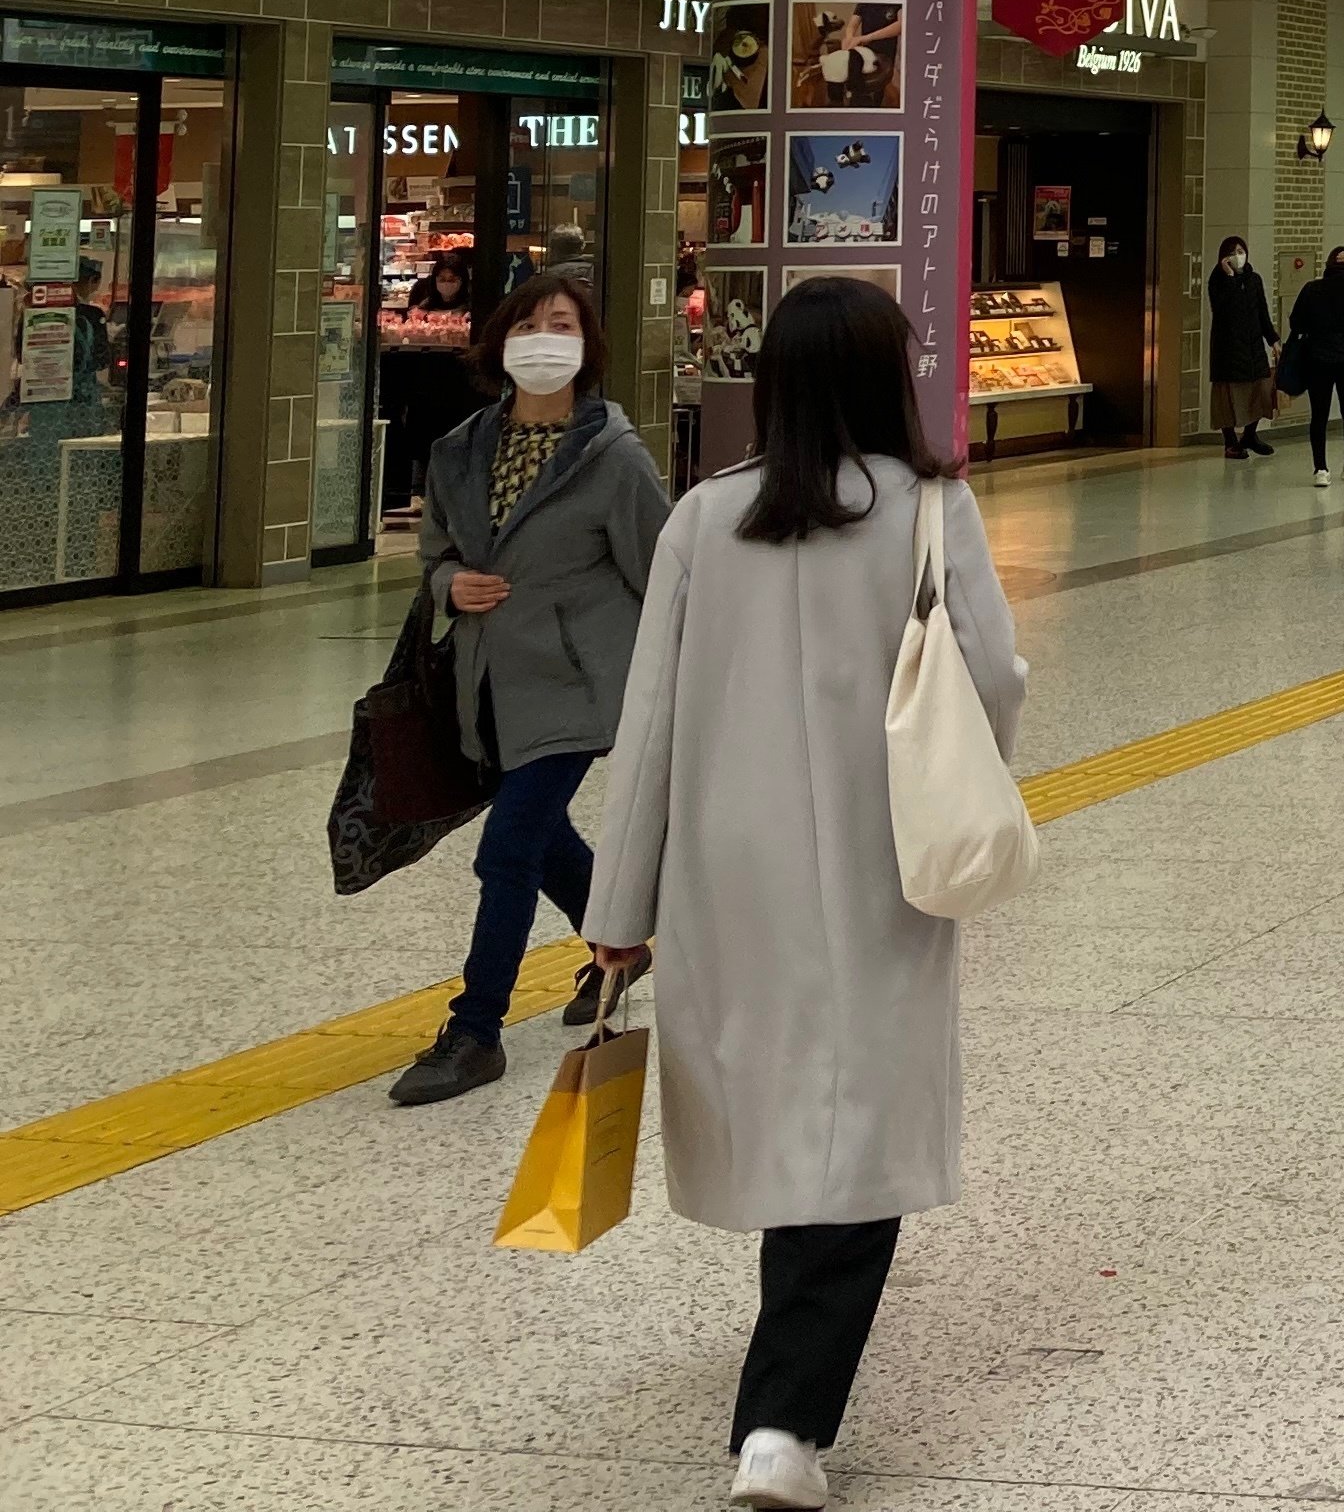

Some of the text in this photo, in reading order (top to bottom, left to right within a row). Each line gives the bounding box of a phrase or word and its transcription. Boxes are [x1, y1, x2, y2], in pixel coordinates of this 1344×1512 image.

[1077, 44, 1142, 75] Belgium 1926
[519, 115, 600, 147] THE
[917, 0, 944, 379] パンダだらけのアトレ上野
